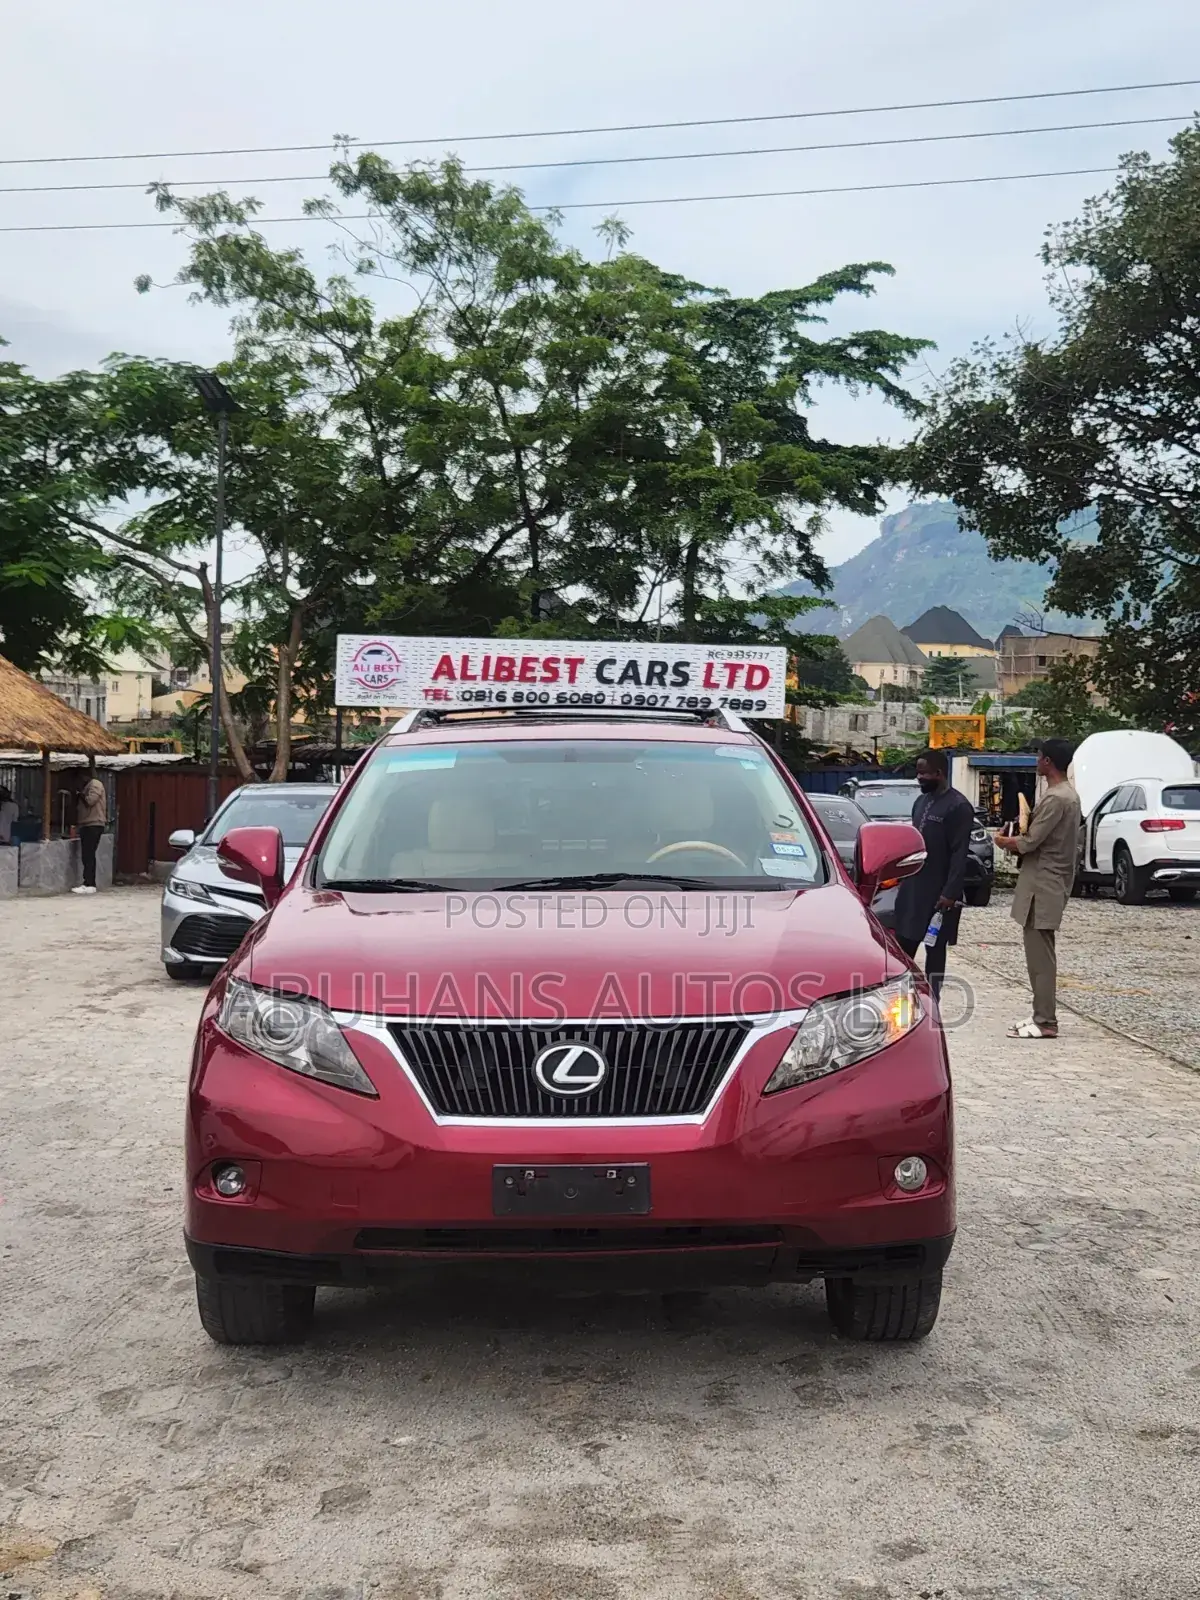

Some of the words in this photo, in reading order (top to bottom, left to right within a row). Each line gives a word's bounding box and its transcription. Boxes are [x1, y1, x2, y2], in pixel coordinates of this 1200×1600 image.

[352, 664, 370, 672] ALI
[374, 665, 401, 673] BEST
[432, 655, 585, 683] ALIBEST
[595, 658, 690, 687] CARS
[702, 662, 770, 691] LTD
[364, 674, 389, 684] CARS
[512, 691, 550, 704] 800
[676, 696, 712, 709] 789
